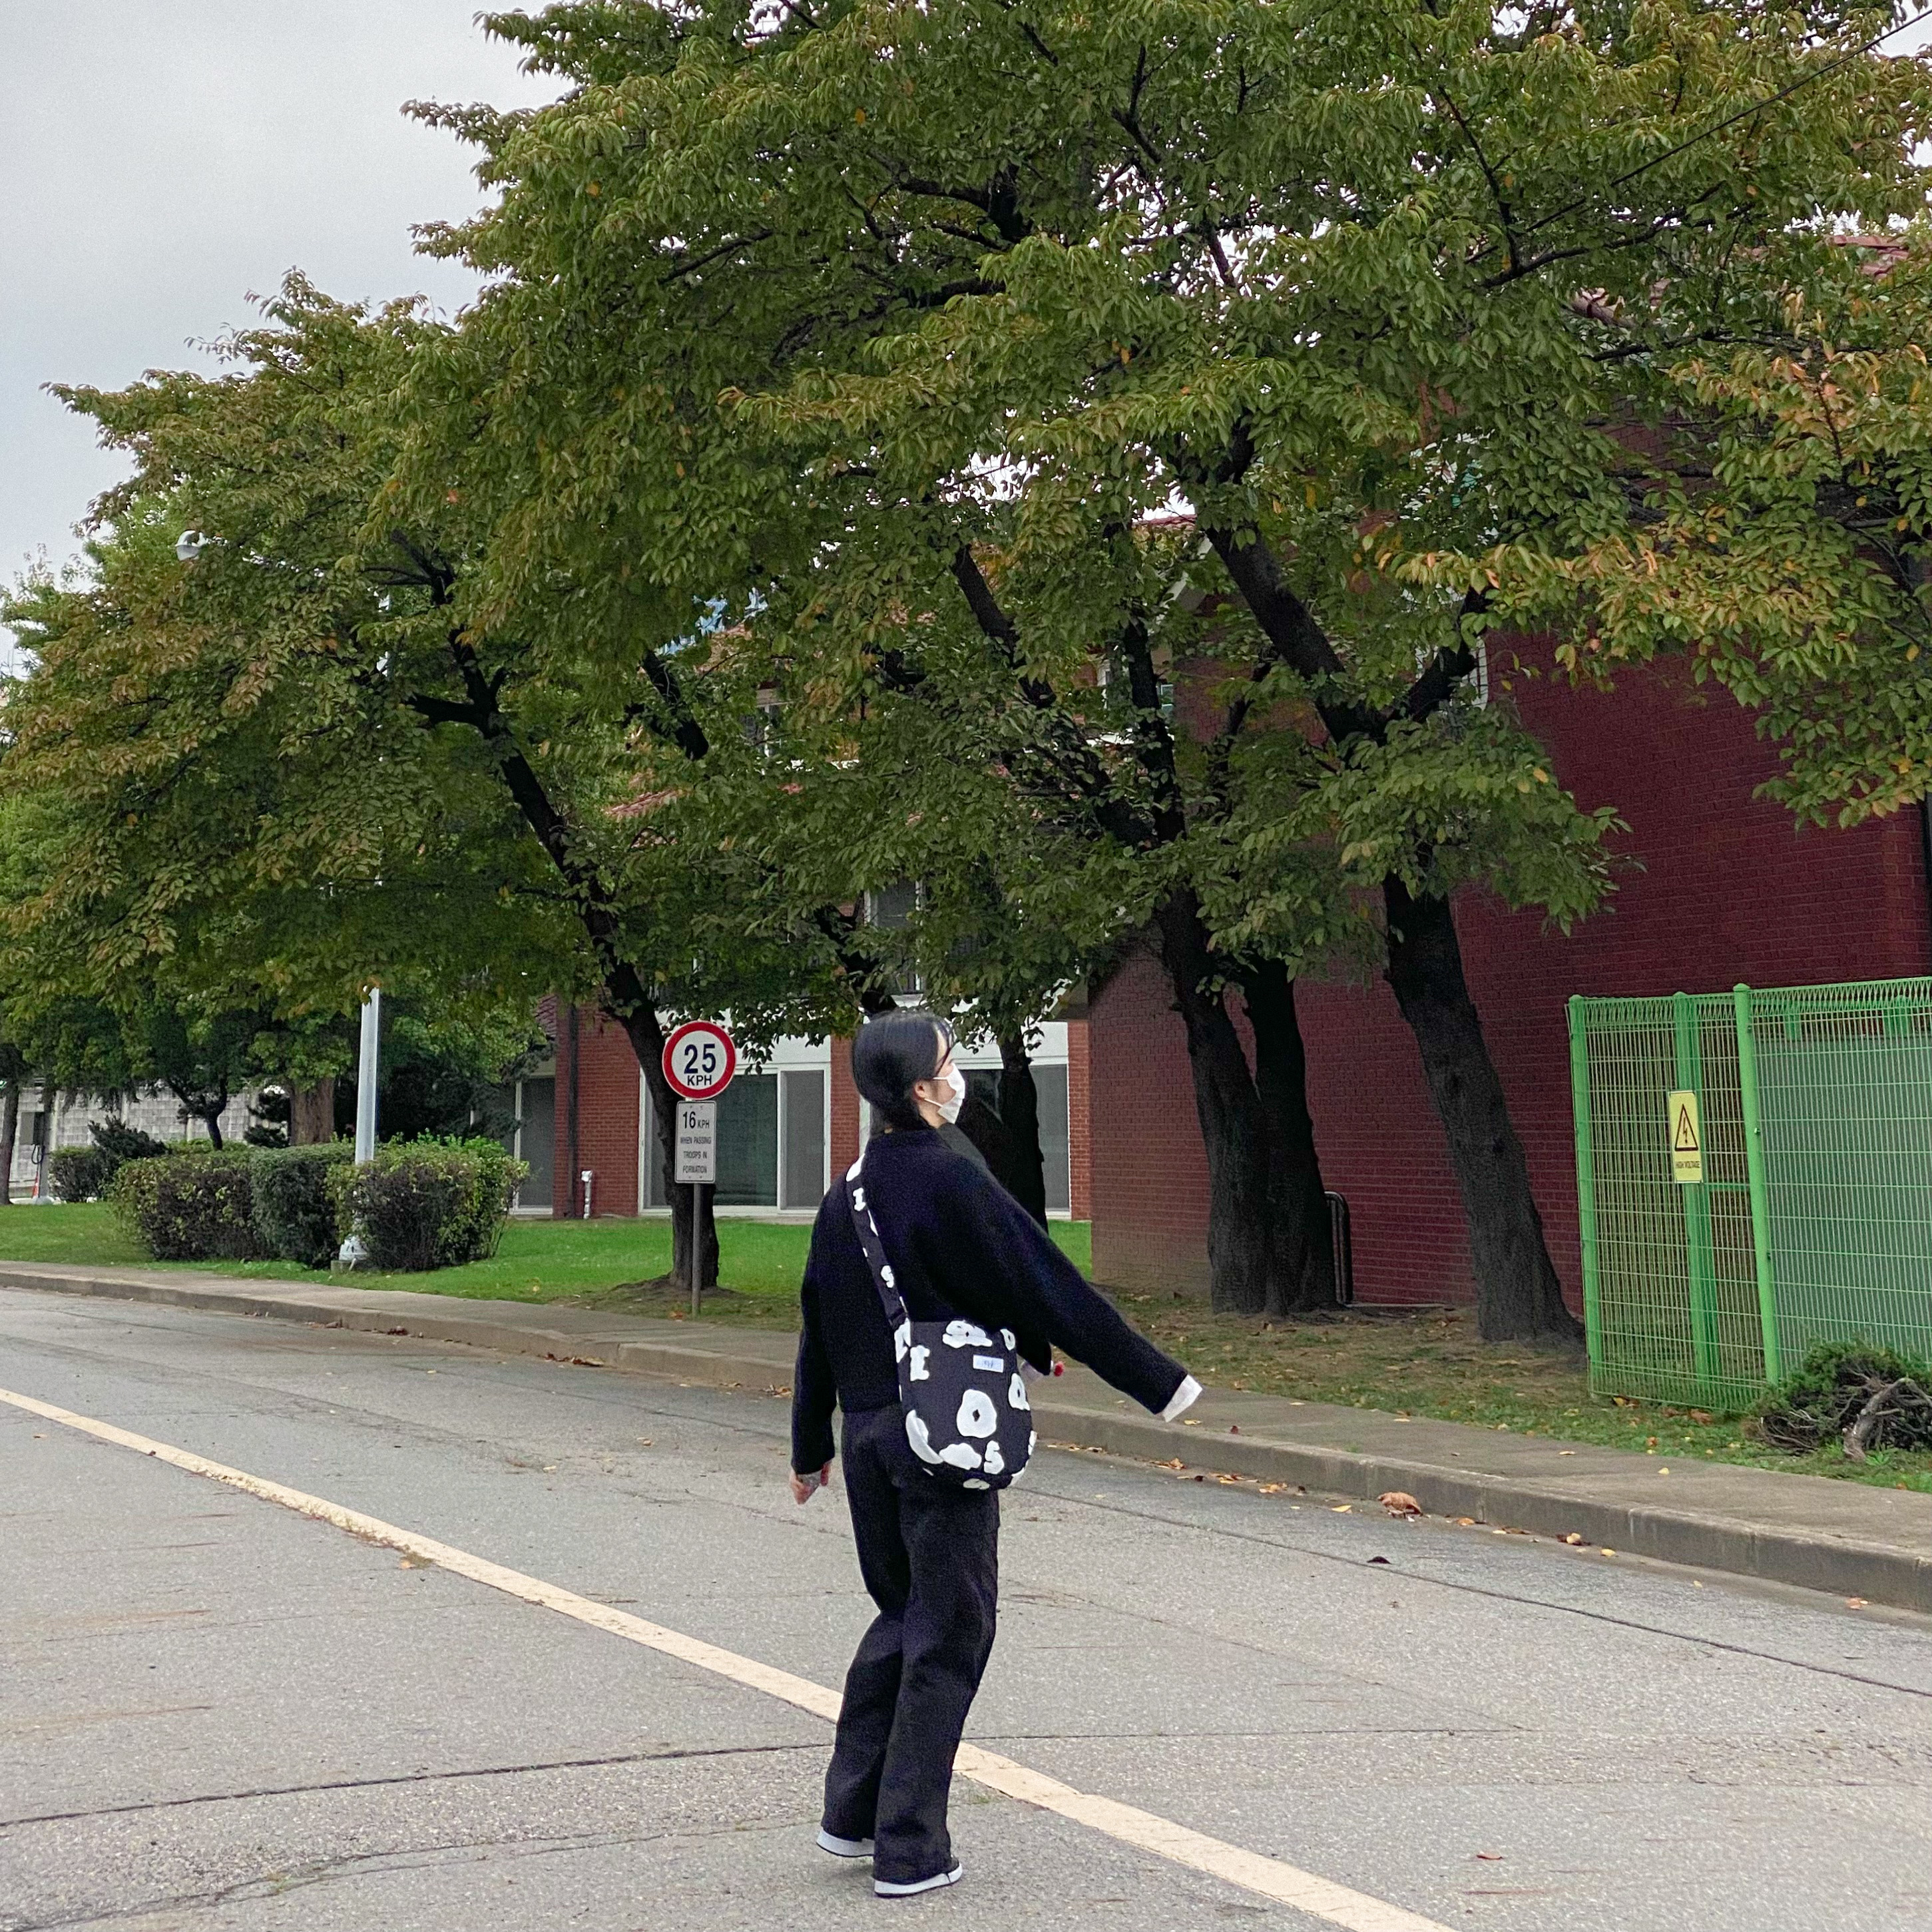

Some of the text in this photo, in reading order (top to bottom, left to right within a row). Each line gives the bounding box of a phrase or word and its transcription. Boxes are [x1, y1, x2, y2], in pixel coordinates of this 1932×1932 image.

[684, 1043, 716, 1074] 25
[687, 1075, 712, 1086] KPH
[683, 1111, 710, 1129] 16 KPH
